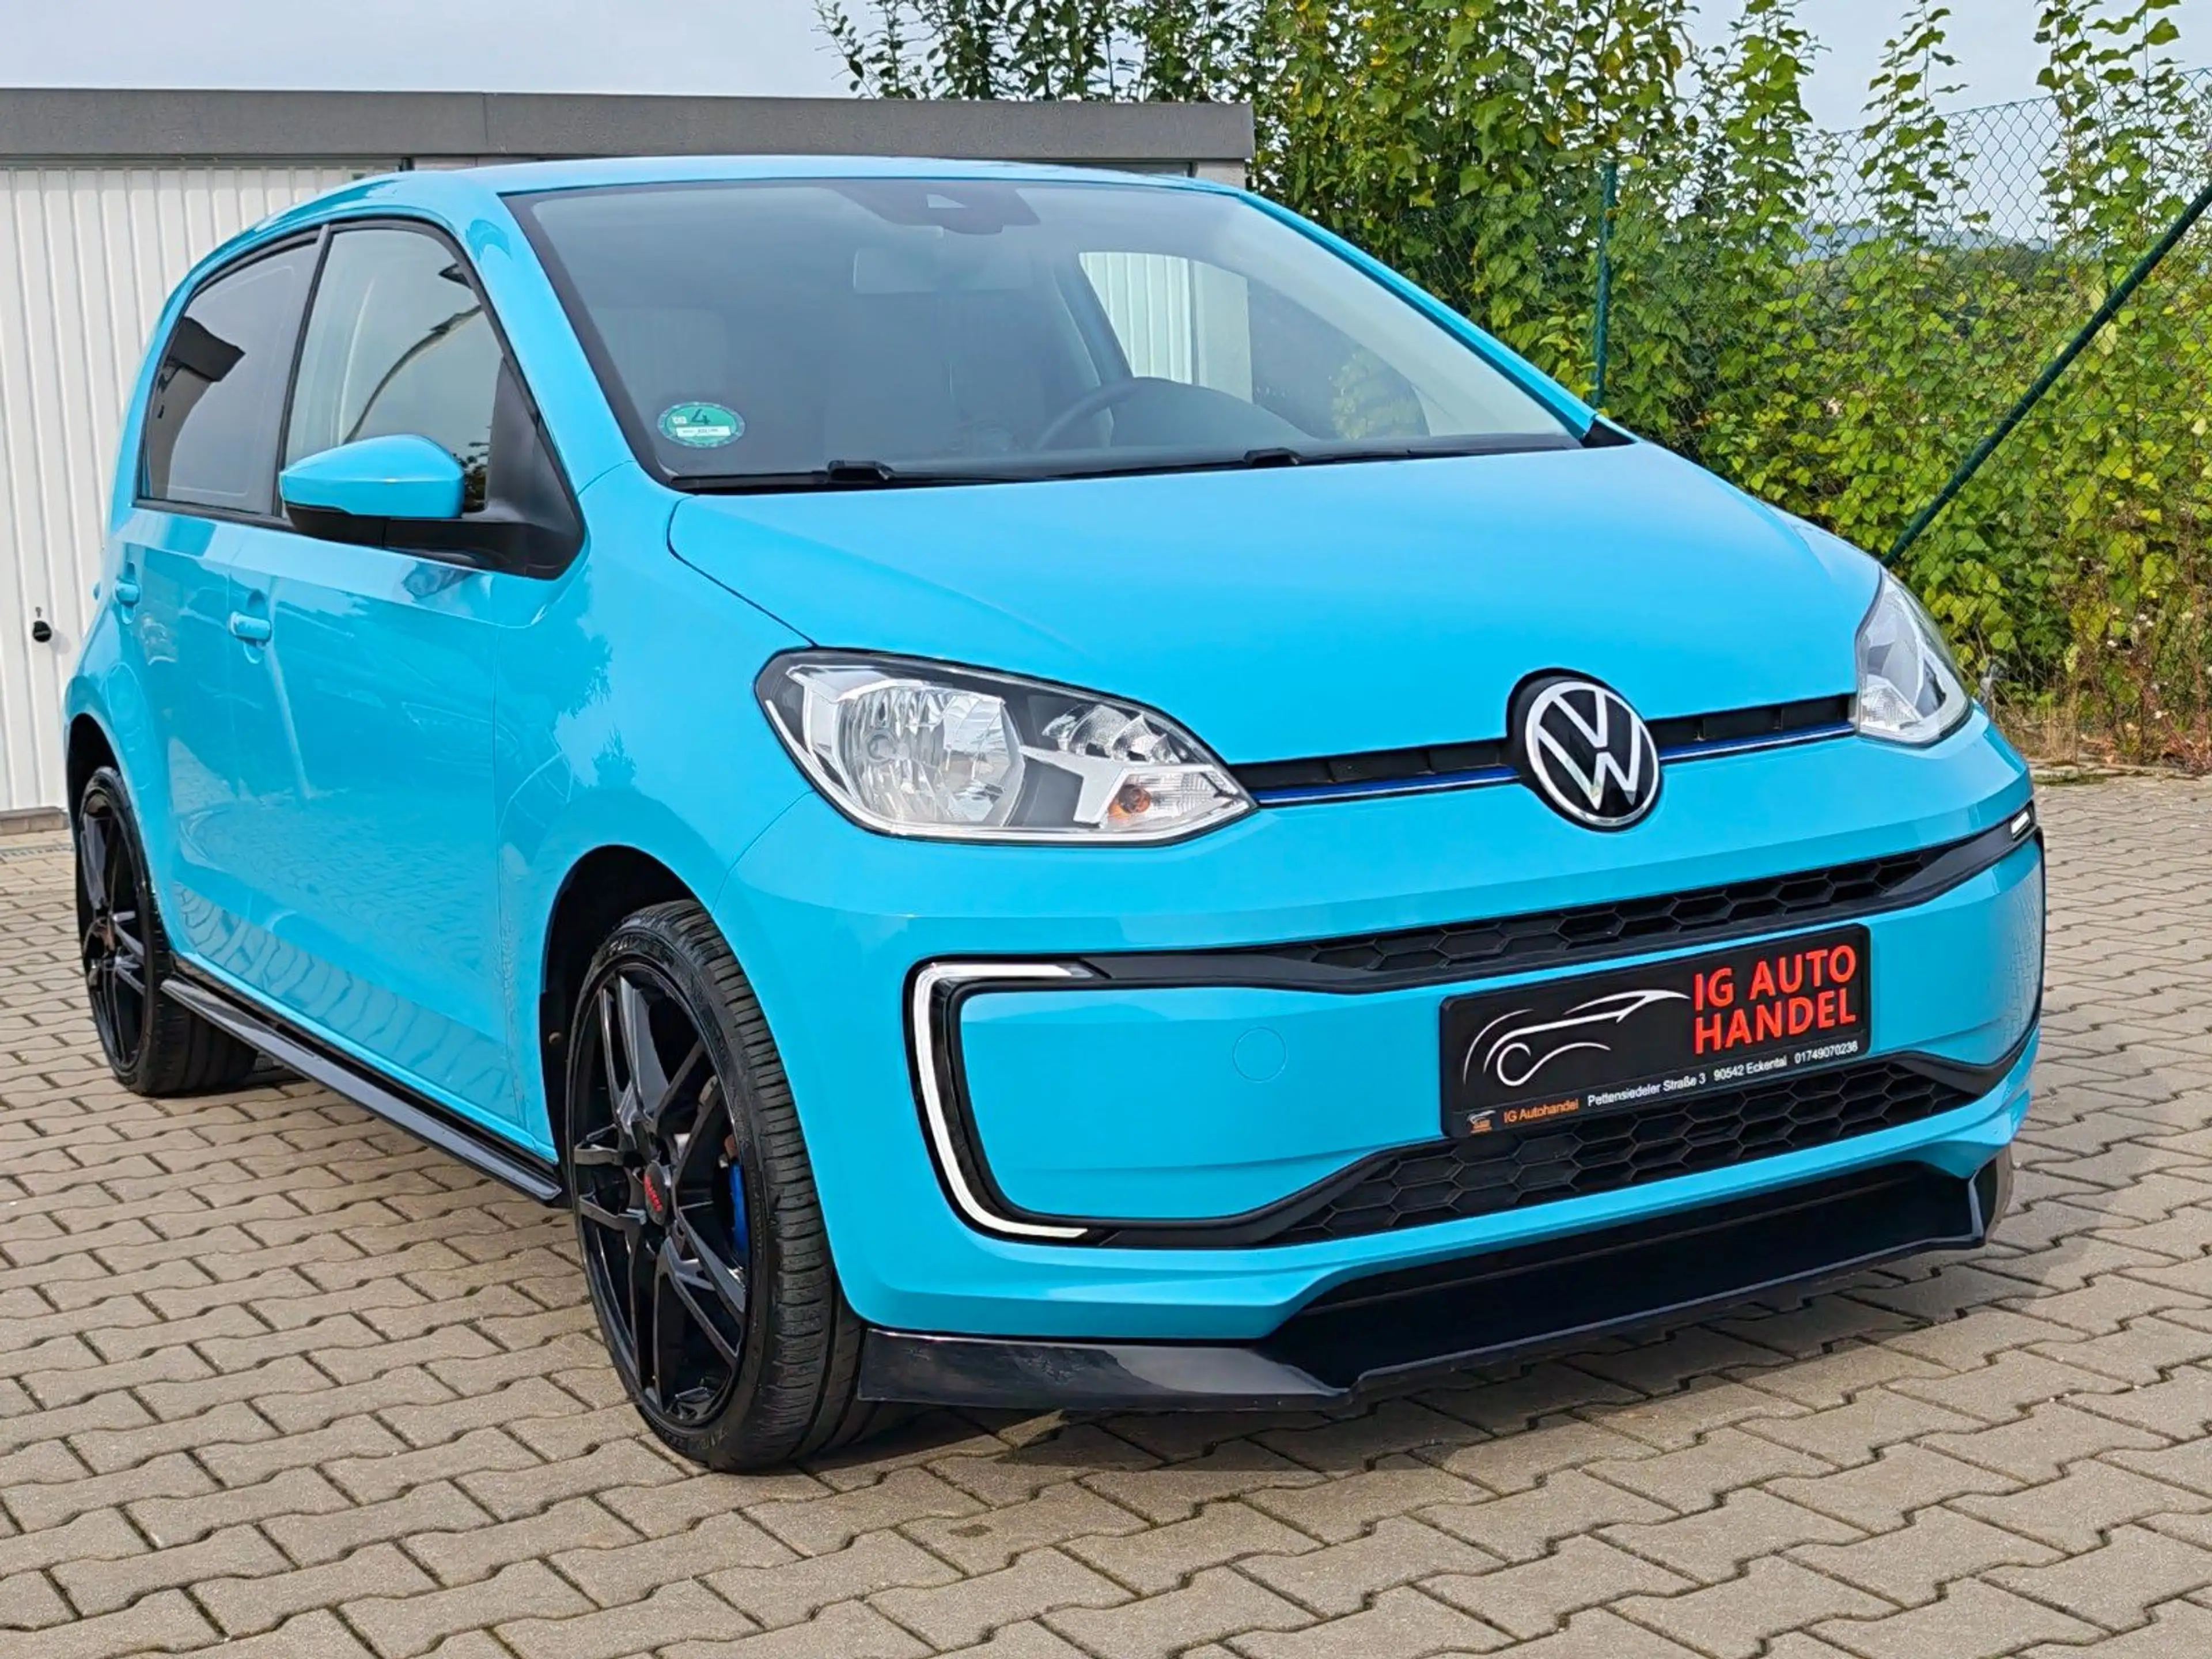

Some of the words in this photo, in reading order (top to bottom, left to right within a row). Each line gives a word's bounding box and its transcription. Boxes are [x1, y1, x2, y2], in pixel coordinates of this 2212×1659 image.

[691, 408, 711, 425] 4
[1532, 687, 1644, 811] VW
[1695, 967, 1734, 1011] IG
[1749, 945, 1856, 1000] AUTO
[1695, 987, 1856, 1054] HANDEL
[1662, 1075, 1697, 1092] Straße
[1699, 1072, 1706, 1084] 3
[1713, 1064, 1744, 1081] 90542
[1745, 1055, 1787, 1074] Eckental
[1503, 1109, 1518, 1123] IG
[1519, 1099, 1578, 1120] Autohandel
